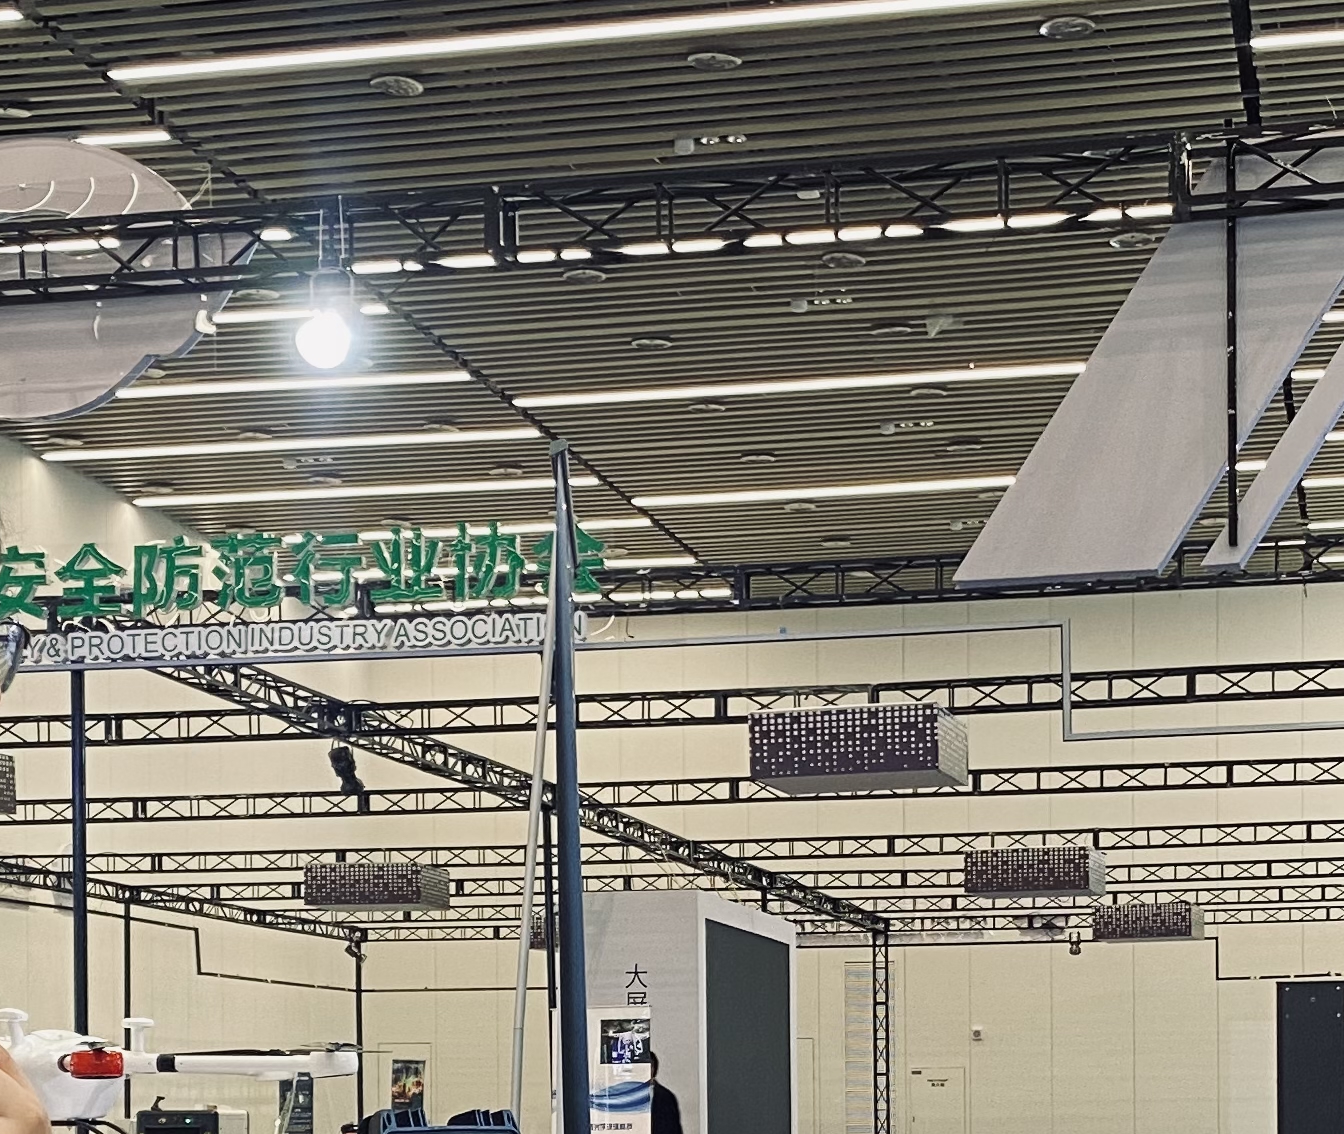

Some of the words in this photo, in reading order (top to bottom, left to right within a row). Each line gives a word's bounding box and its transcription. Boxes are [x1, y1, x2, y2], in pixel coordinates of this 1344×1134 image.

[71, 629, 242, 658] PROTECTION
[251, 623, 387, 648] INDUSTRY
[394, 613, 583, 643] ASSOCIATIN
